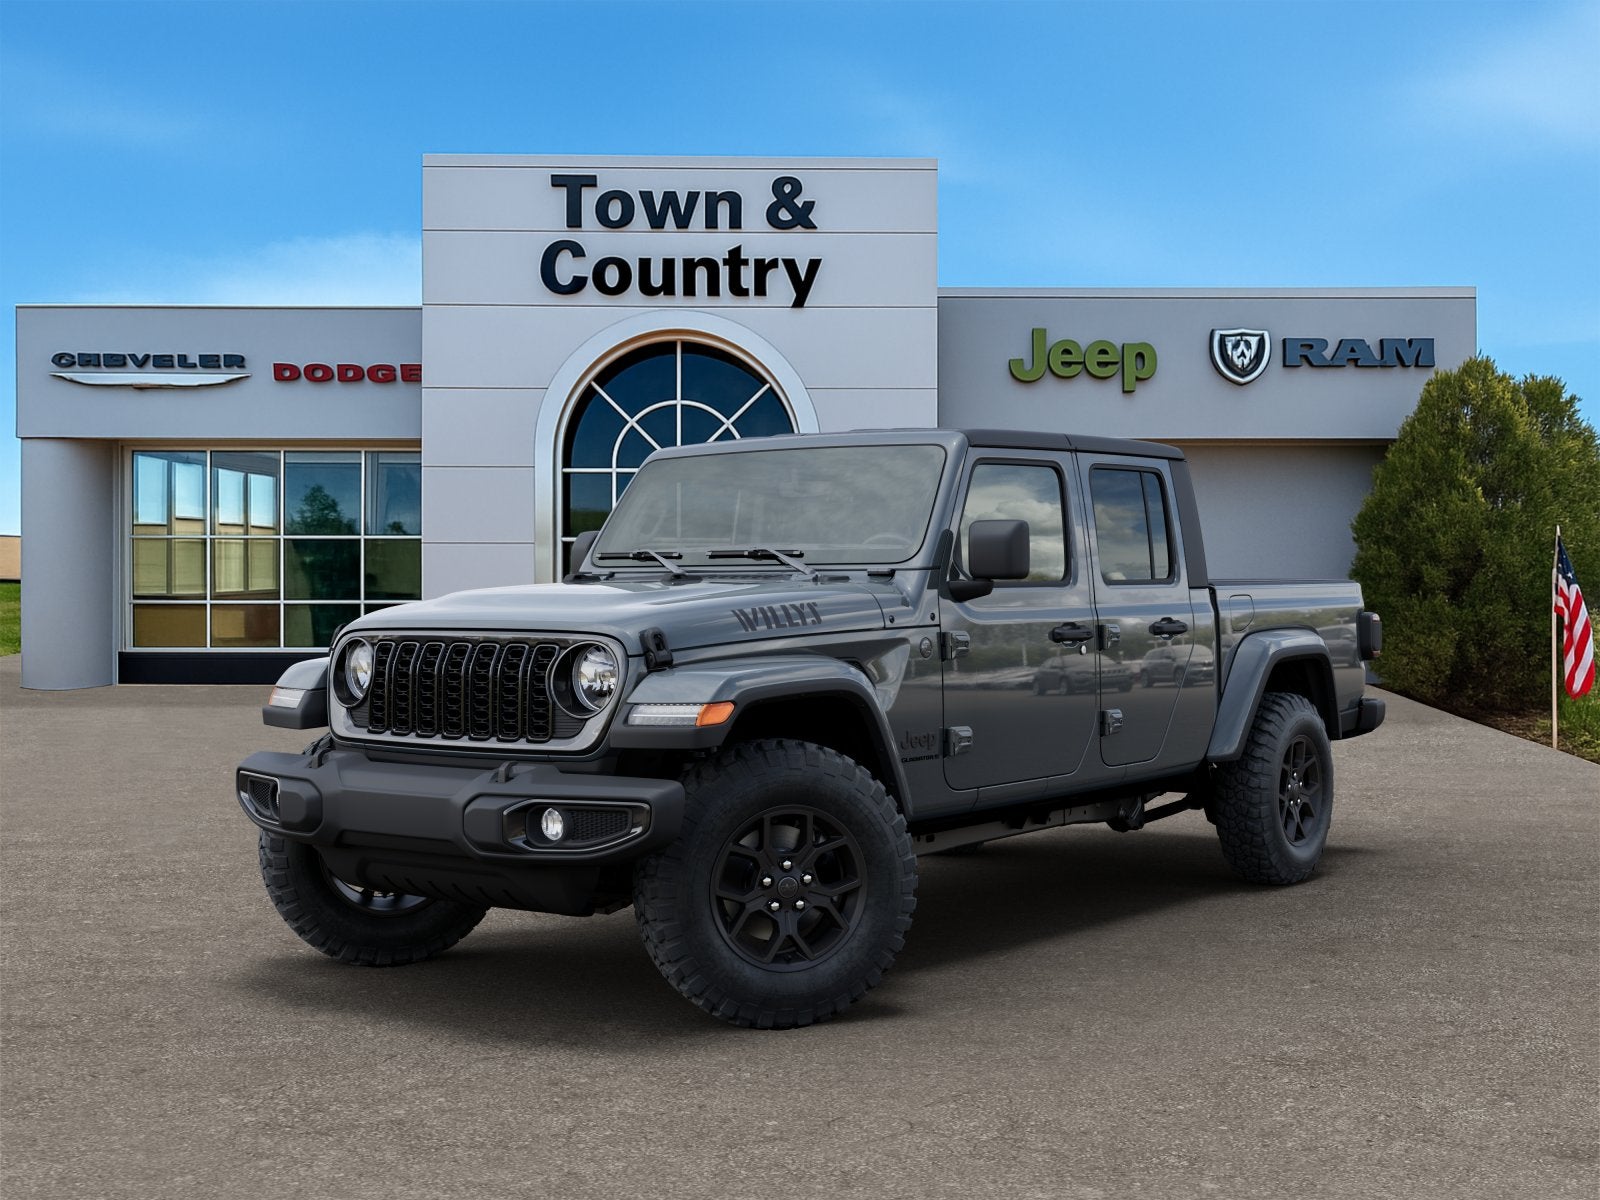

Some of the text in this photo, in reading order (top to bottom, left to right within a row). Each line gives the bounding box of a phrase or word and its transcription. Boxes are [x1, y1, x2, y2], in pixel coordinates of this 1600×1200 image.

[551, 174, 818, 229] Town &
[540, 239, 822, 308] Country
[1009, 328, 1158, 393] Jeep
[1283, 337, 1436, 368] RAM
[272, 363, 422, 384] DODGE
[731, 602, 822, 632] WILLYS
[900, 730, 935, 751] Jeep
